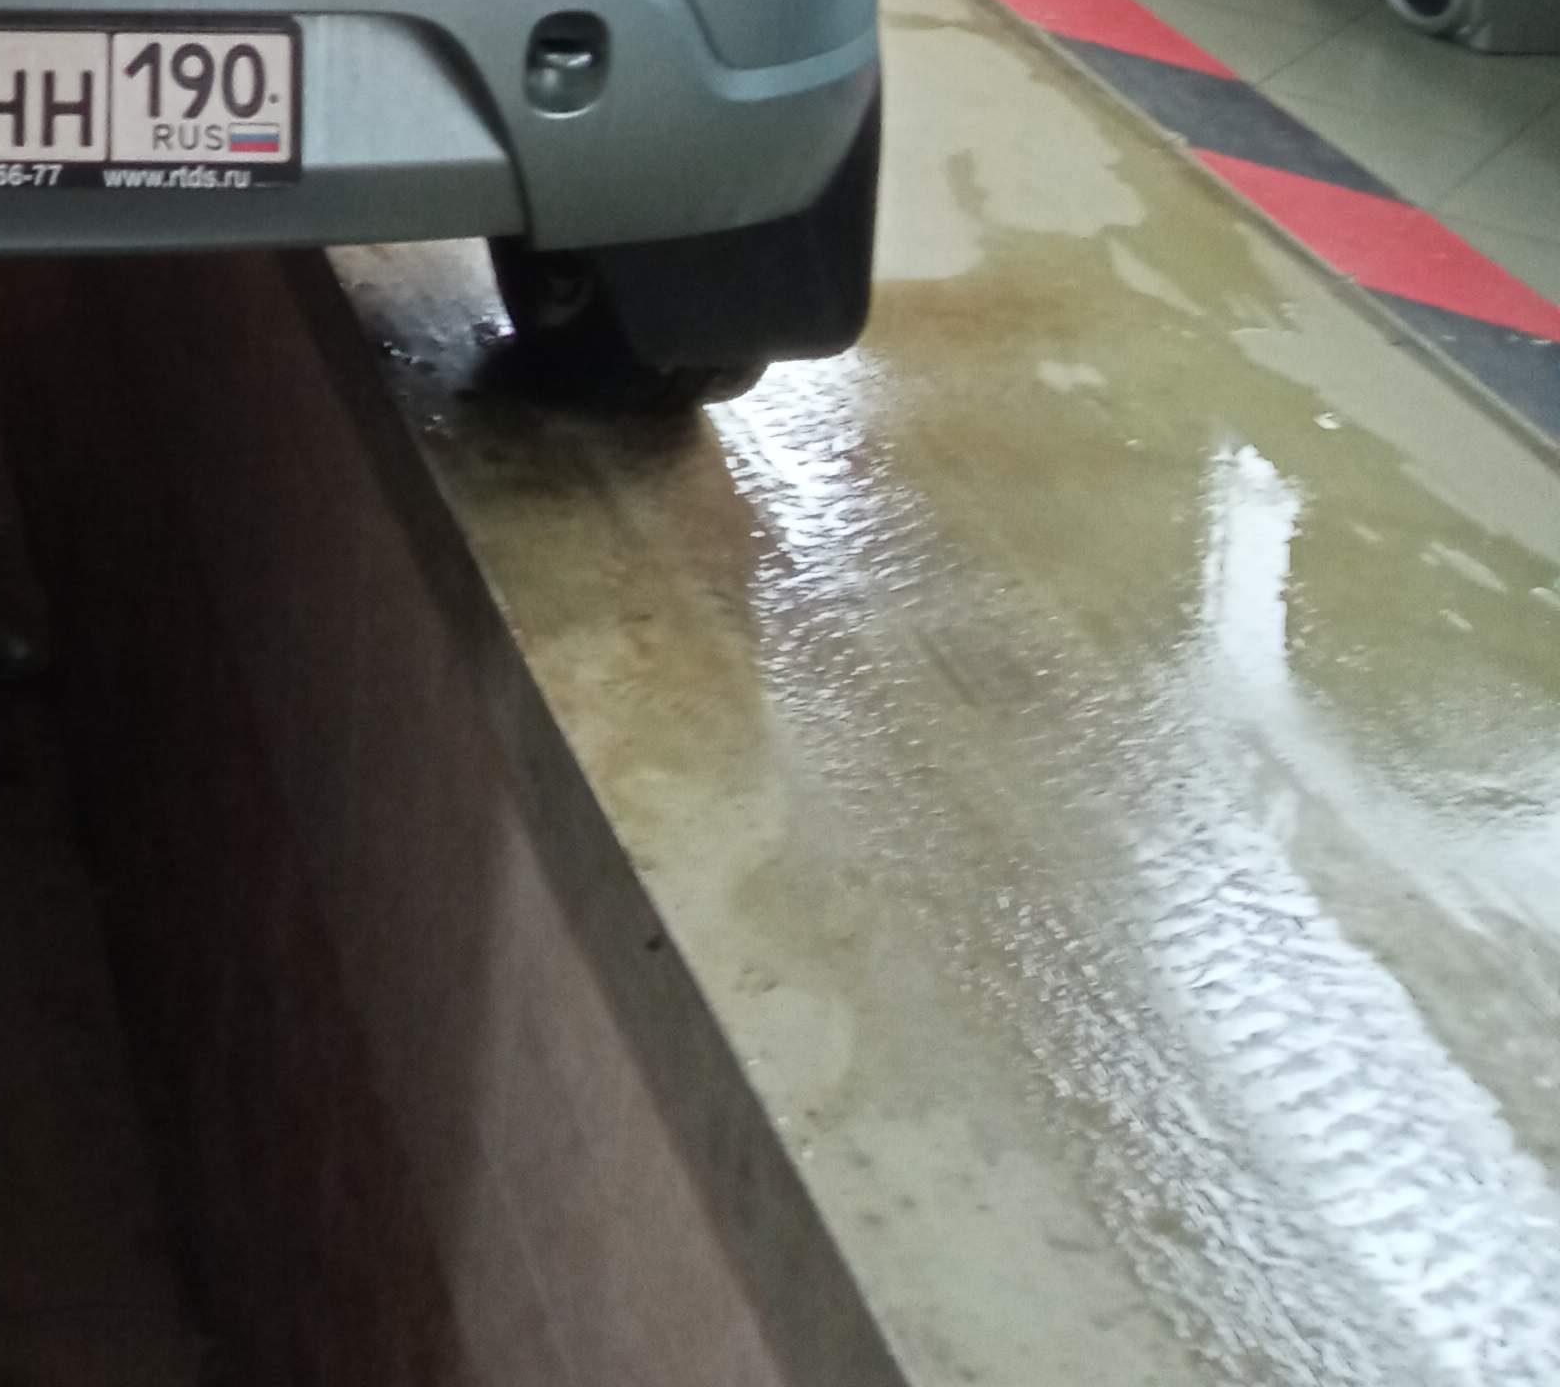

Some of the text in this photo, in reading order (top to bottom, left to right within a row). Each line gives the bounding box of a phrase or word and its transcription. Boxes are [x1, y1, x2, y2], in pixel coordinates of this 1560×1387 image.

[124, 41, 266, 121] 190
[152, 125, 224, 151] RUS
[104, 165, 251, 189] www.rtds.ru
